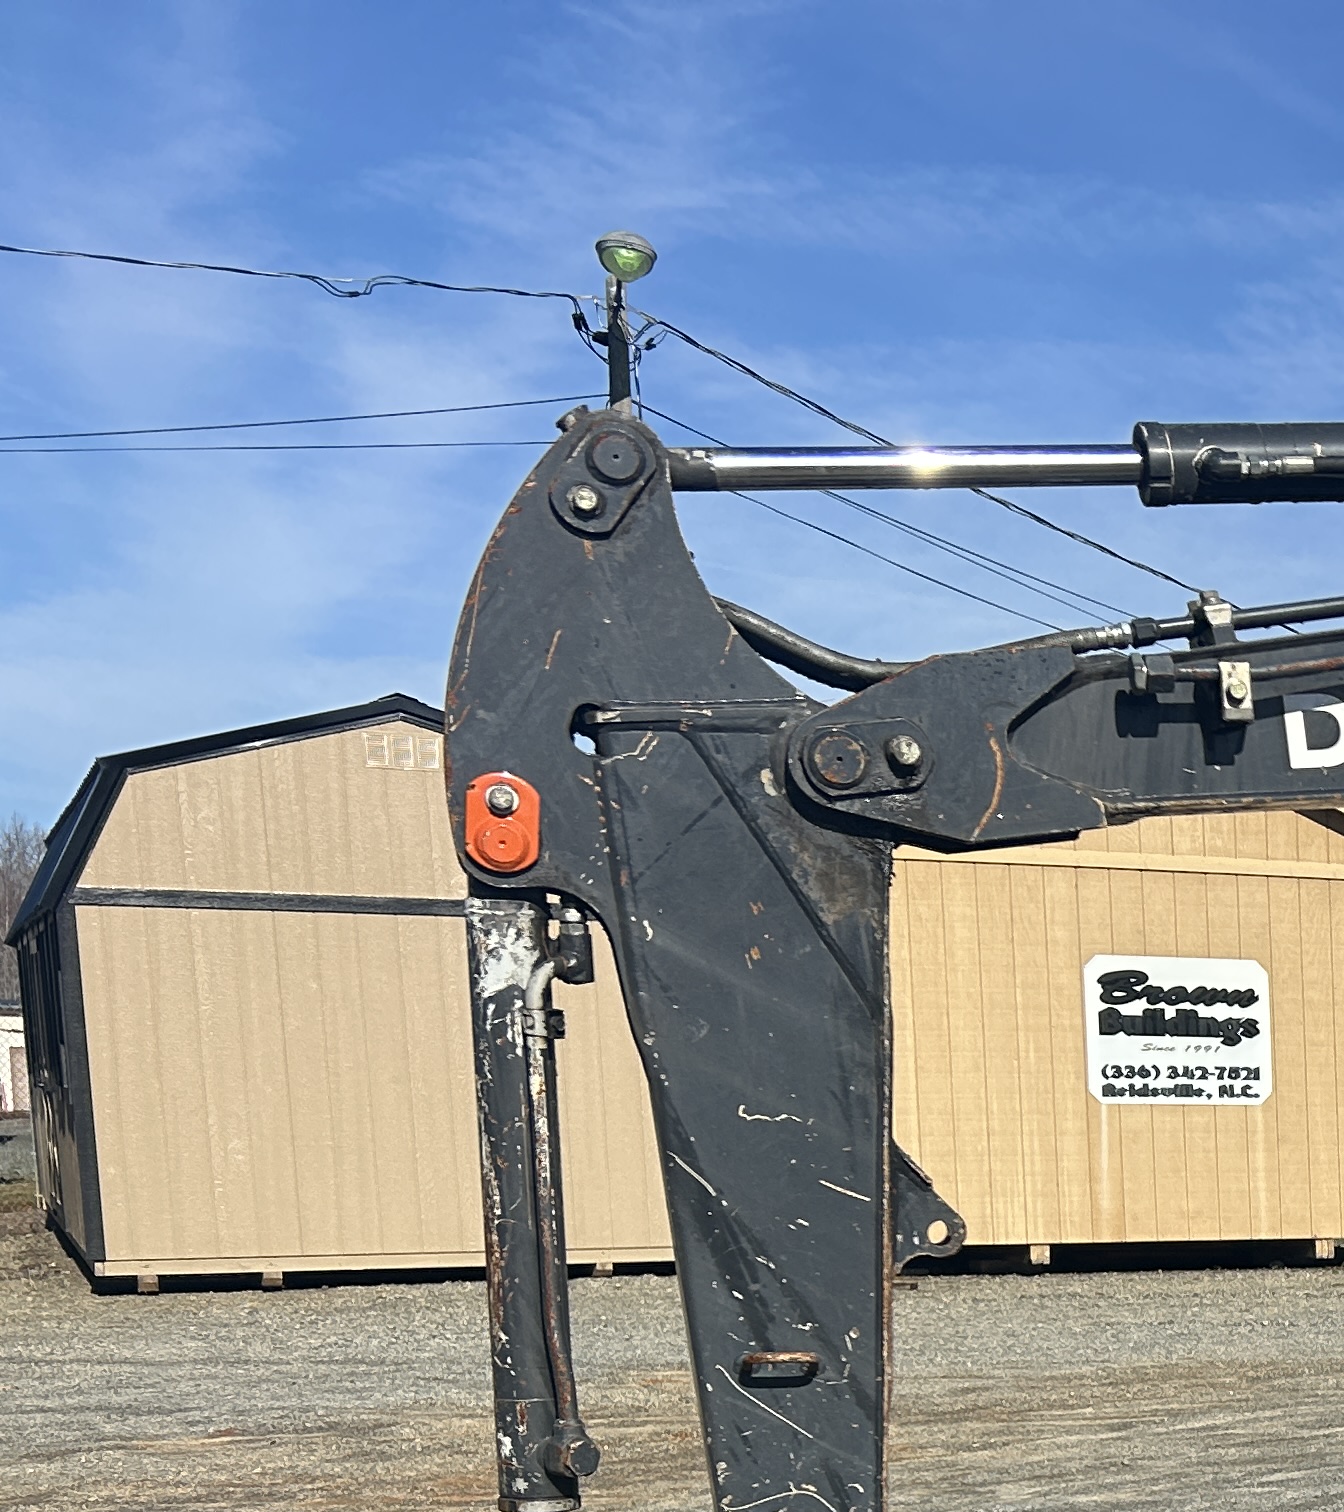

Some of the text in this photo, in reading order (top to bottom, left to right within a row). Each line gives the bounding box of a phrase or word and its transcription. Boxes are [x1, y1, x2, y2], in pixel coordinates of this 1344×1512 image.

[1097, 970, 1259, 1008] Brown
[1098, 1007, 1260, 1046] Buildings
[1141, 1043, 1221, 1053] Since 1991
[1101, 1064, 1260, 1080] (336) 342-7521
[1218, 1084, 1260, 1098] N.C.
